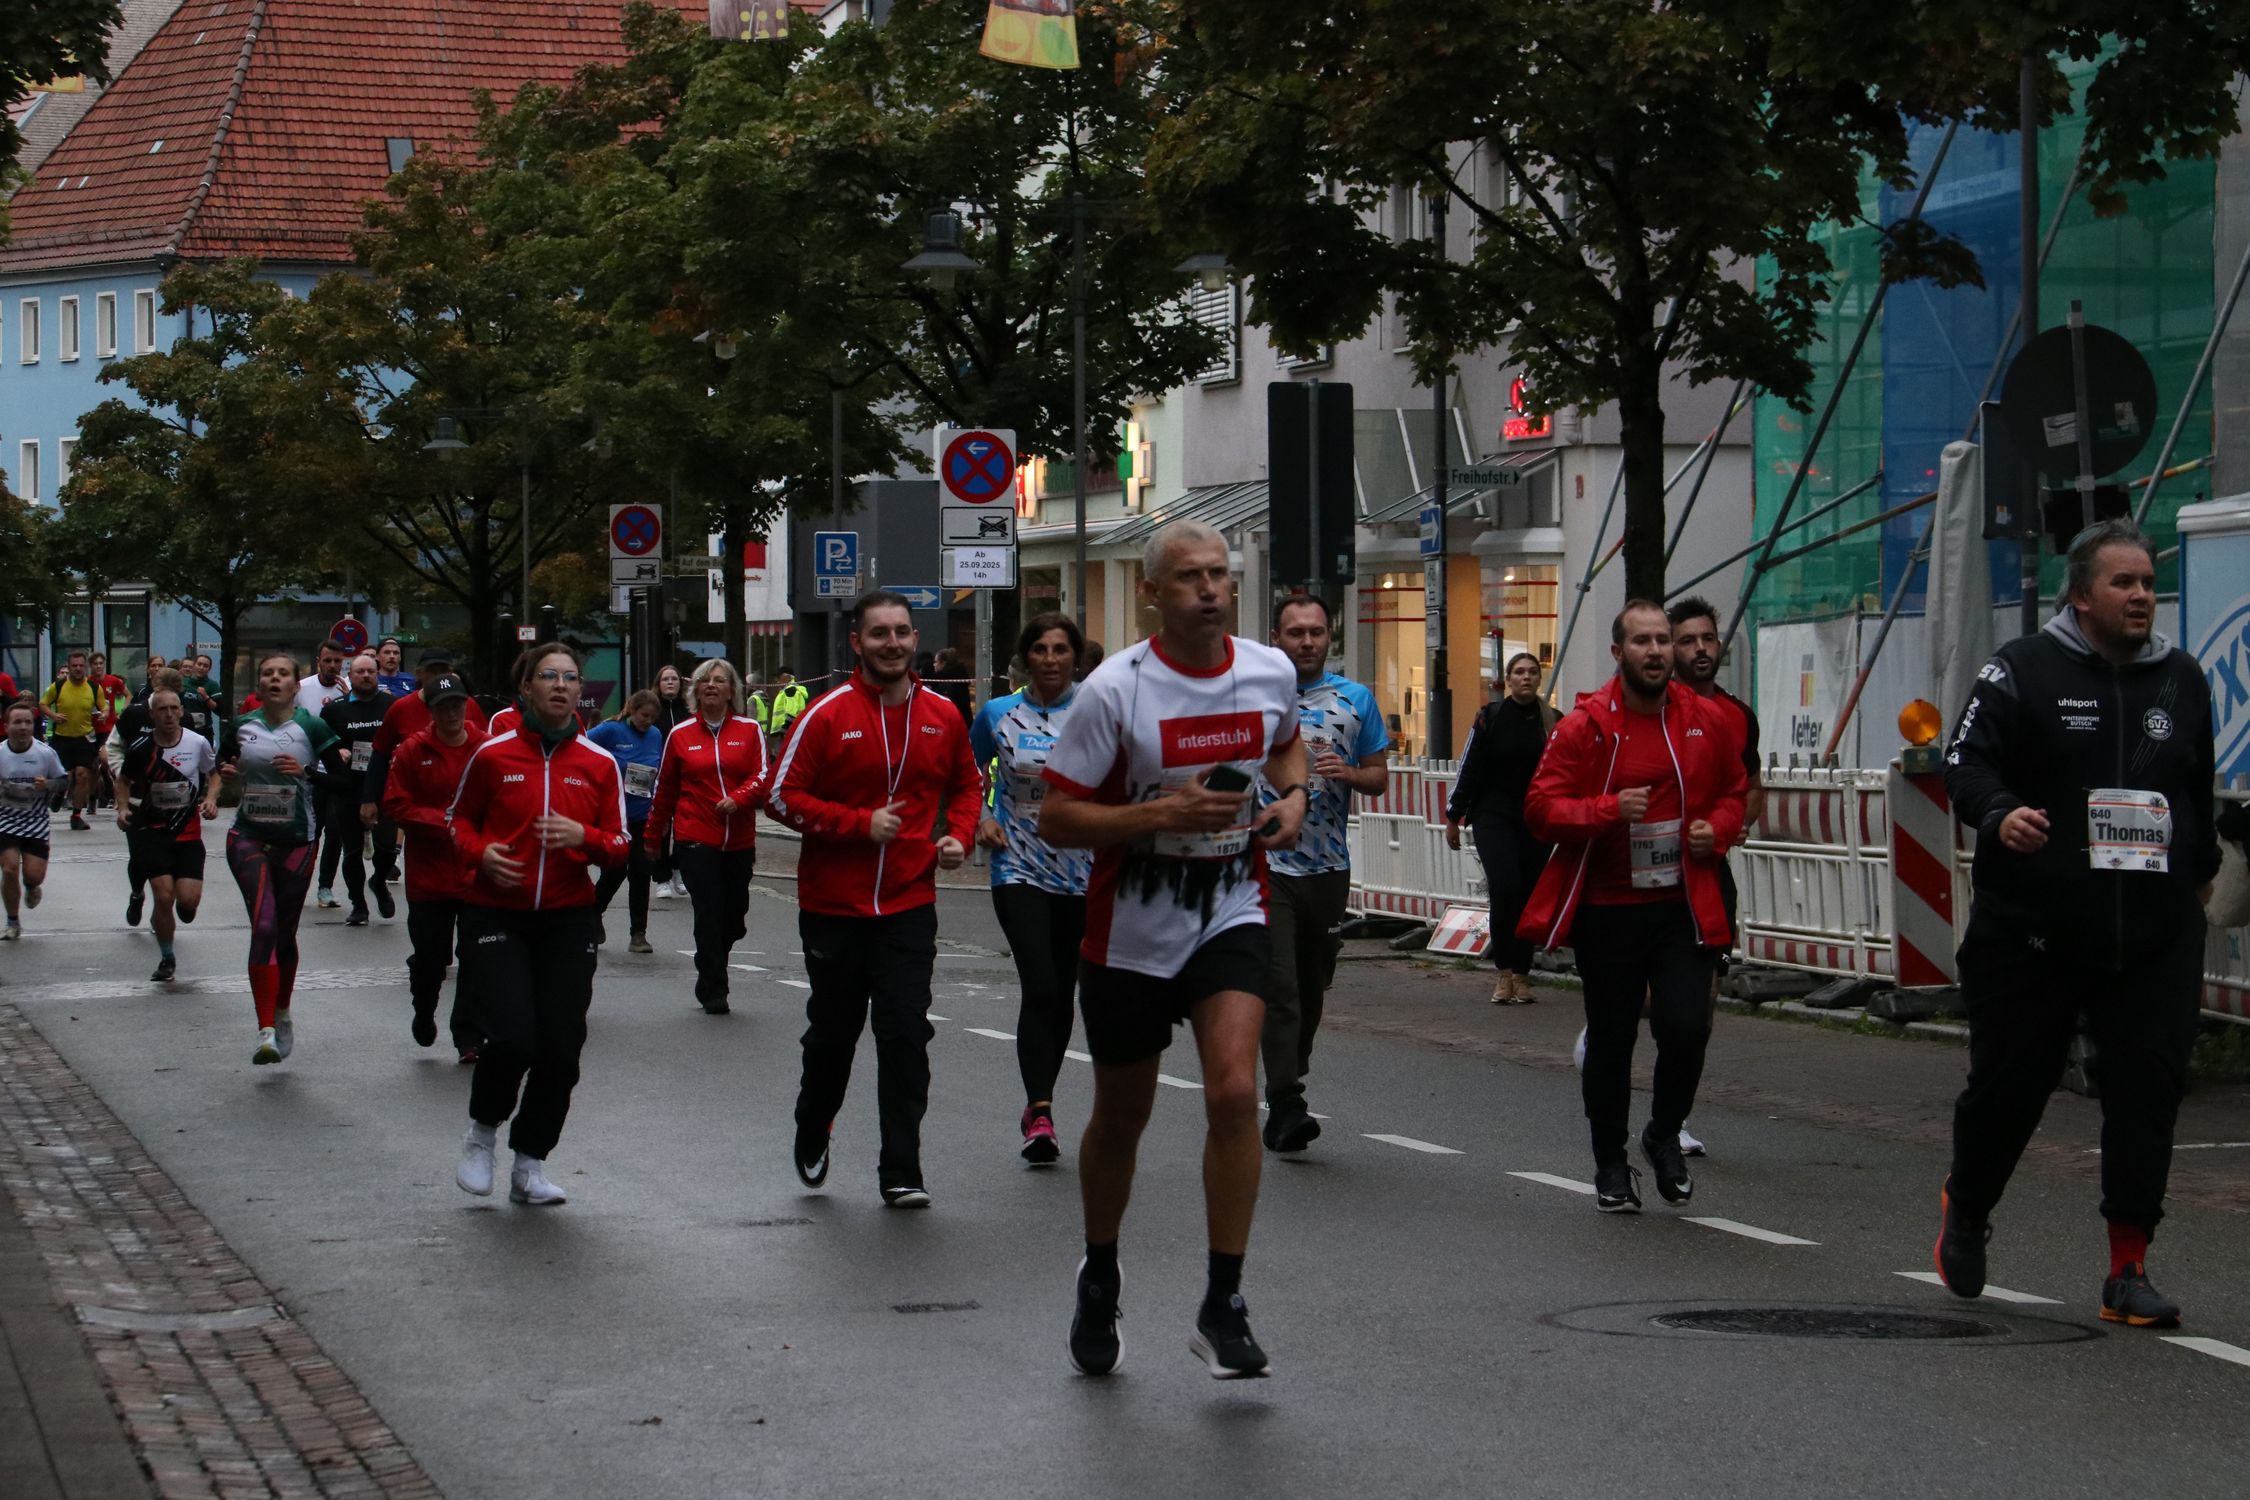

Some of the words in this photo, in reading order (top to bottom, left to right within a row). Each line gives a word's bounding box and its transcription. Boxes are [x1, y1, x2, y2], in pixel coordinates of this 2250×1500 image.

[1452, 469, 1511, 485] Freihofstr.
[960, 561, 1000, 569] 25.09.2025
[2057, 697, 2098, 709] uhlsport
[2147, 718, 2169, 730] SVZ
[841, 730, 863, 741] JAKO
[921, 725, 936, 735] elco
[1177, 727, 1251, 749] interstuhl
[503, 773, 525, 783] JAKO
[563, 776, 581, 786] elco
[247, 804, 288, 816] Daniela
[2090, 808, 2111, 819] 640
[2095, 822, 2164, 843] Thomas
[2145, 858, 2160, 869] 640
[478, 935, 497, 945] elco
